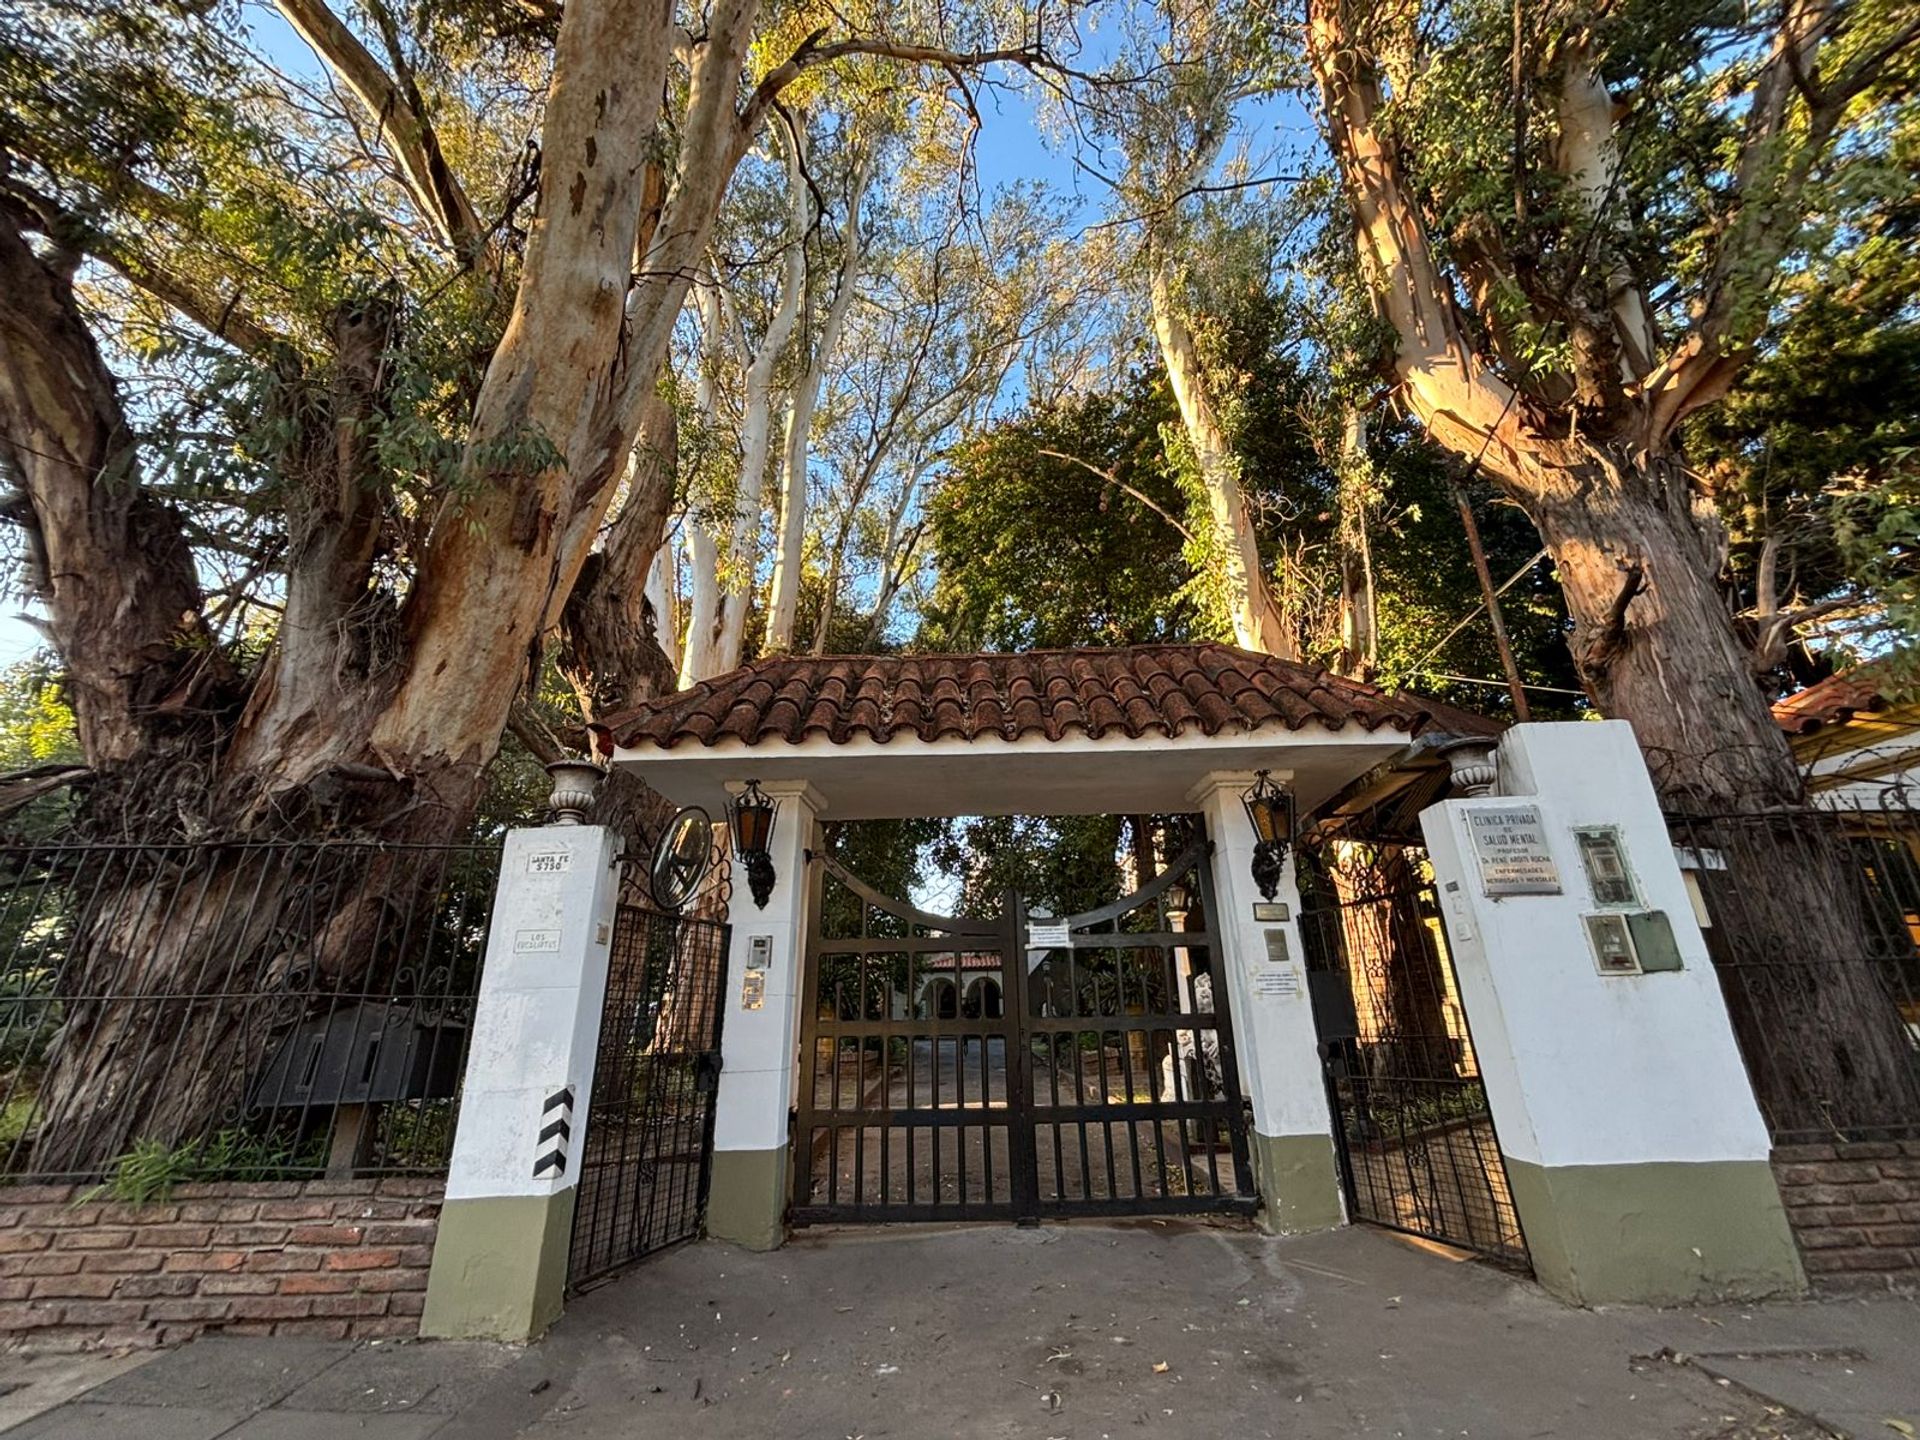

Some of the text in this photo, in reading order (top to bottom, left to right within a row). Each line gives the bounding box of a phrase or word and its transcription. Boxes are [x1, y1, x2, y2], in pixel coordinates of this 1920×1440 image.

[1504, 814, 1537, 826] PRIVADA
[1483, 833, 1538, 846] SALUD MENTAL
